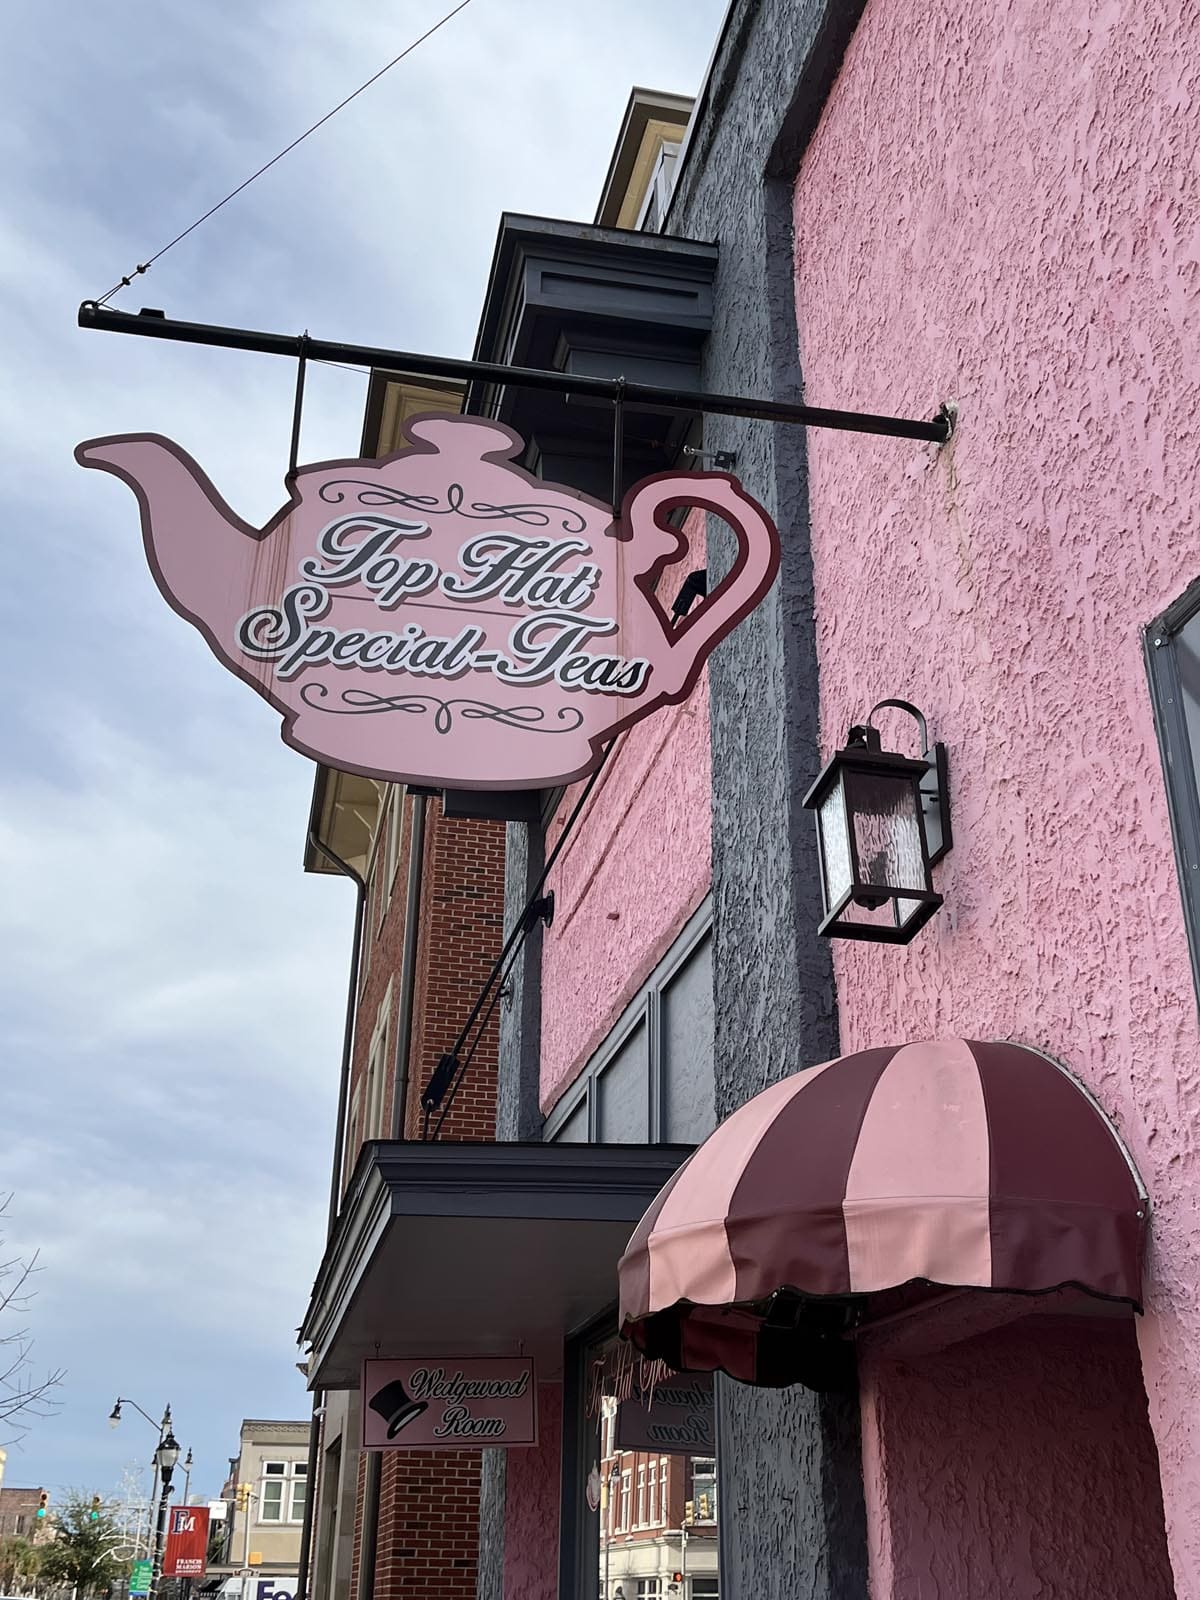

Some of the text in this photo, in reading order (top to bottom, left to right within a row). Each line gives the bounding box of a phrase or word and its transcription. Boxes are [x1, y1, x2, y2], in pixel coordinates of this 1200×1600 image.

[302, 513, 600, 609] Top Hat
[235, 585, 650, 694] Special-Teas
[409, 1367, 529, 1405] Wedgewood
[433, 1406, 506, 1438] Room
